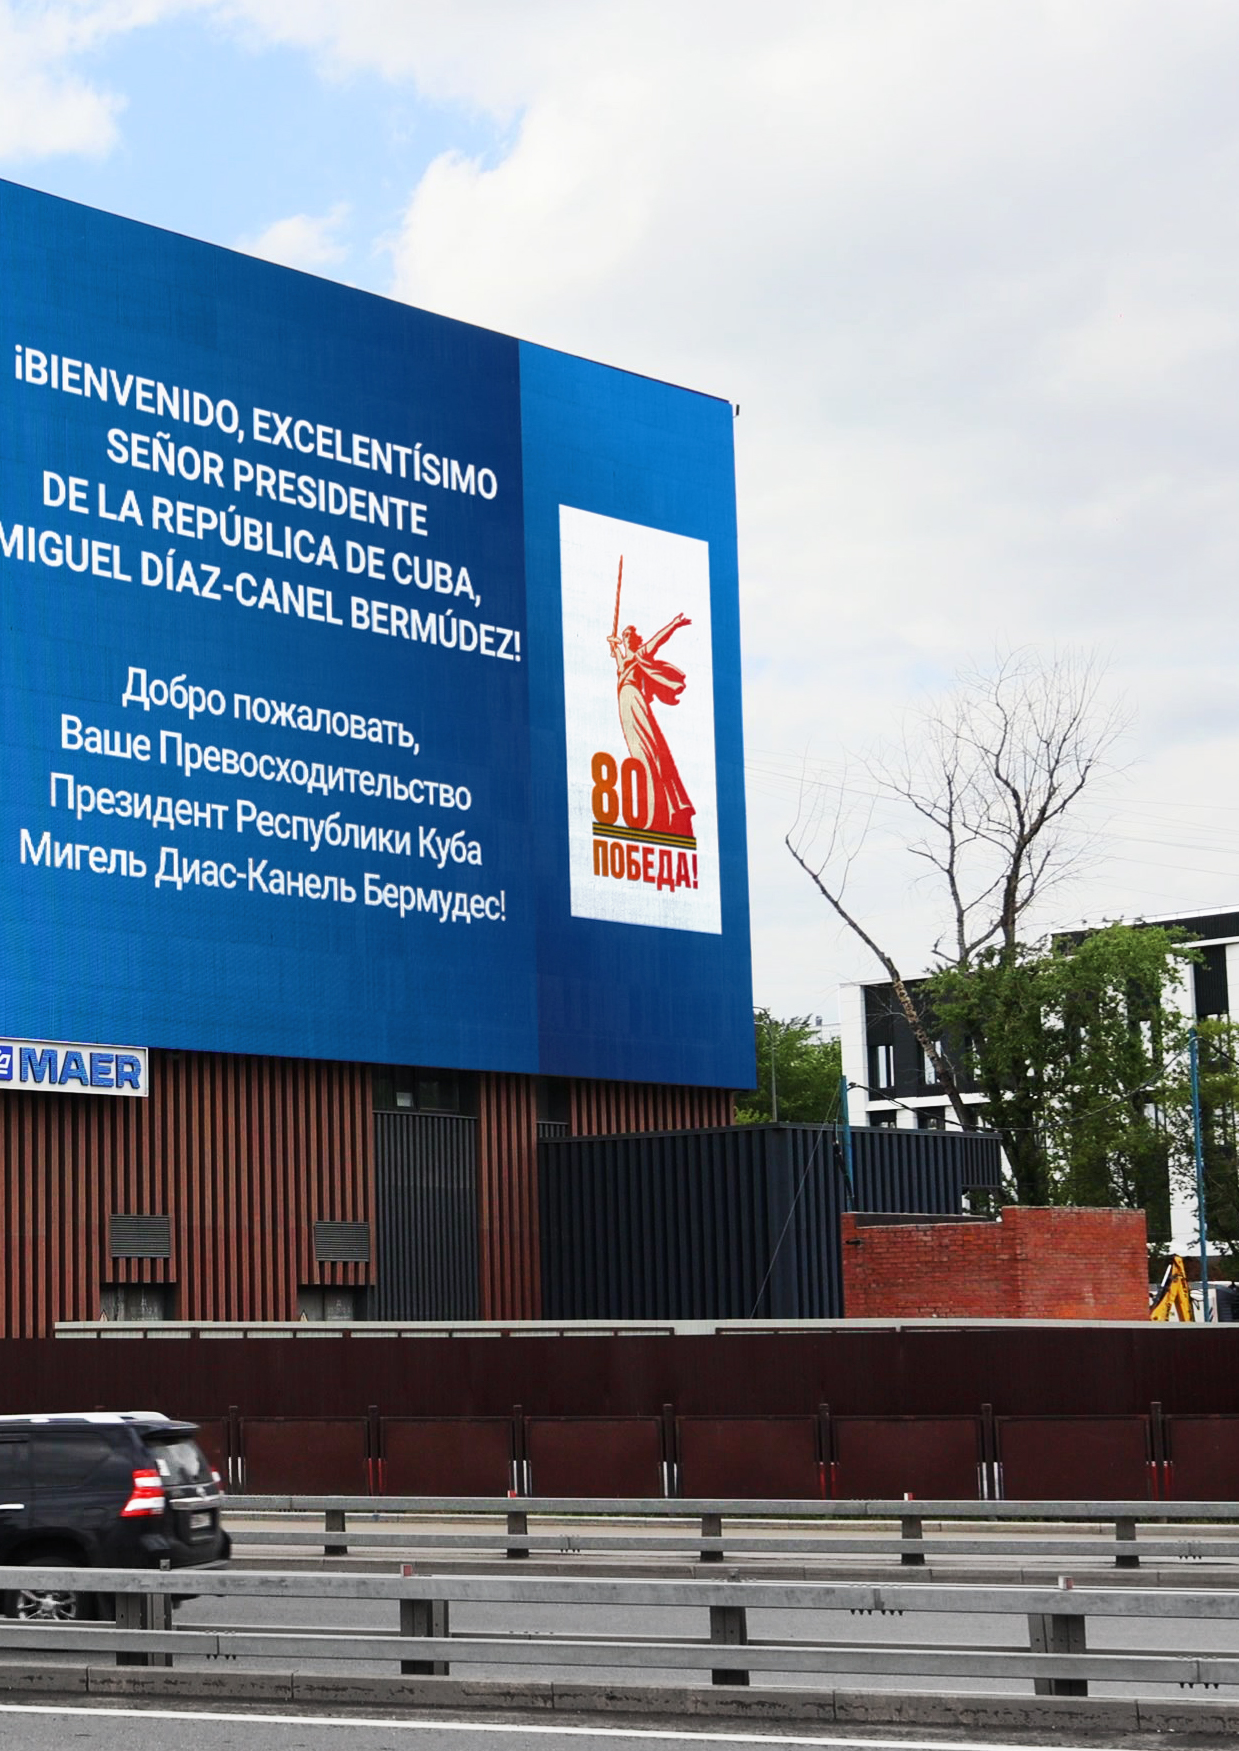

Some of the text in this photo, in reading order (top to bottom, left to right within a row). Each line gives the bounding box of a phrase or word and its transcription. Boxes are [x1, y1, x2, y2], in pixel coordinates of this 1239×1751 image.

[14, 344, 498, 500] ¡BIENVENIDO, EXCELENTÍSIMO
[106, 427, 428, 537] SEÑOR PRESIDENTE
[43, 470, 481, 608] DE LA REPÚBLICA DE CUBA,
[141, 548, 344, 626] DÍAZ-CANEL
[350, 595, 521, 662] BERMÚDEZ!
[121, 666, 420, 756] Добро пожаловать,
[61, 713, 472, 811] Ваше Превосходительство
[591, 751, 650, 829] 80
[50, 771, 483, 869] Президент Республики Куба
[593, 838, 699, 893] ПОБЕДА!
[20, 828, 506, 924] Мигель Диас-Канель Бермудес!
[19, 1046, 142, 1089] MAER
